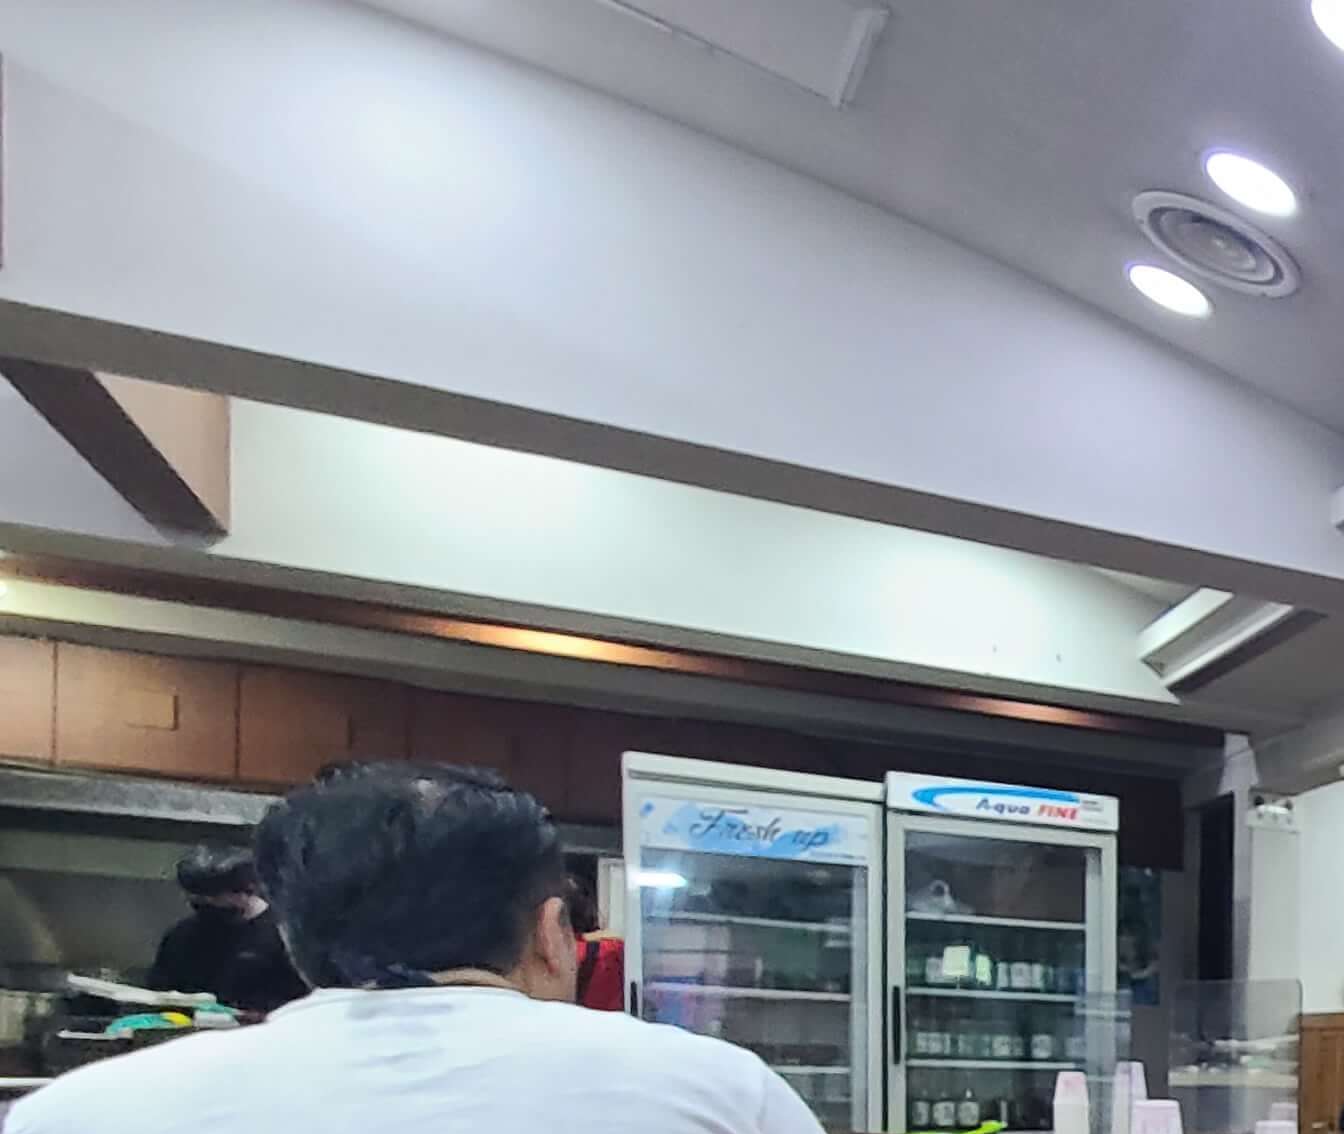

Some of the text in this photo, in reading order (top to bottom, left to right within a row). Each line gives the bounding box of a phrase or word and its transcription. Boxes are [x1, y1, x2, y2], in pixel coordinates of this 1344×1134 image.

[975, 798, 1030, 815] Aqua
[689, 807, 830, 850] Fresh up
